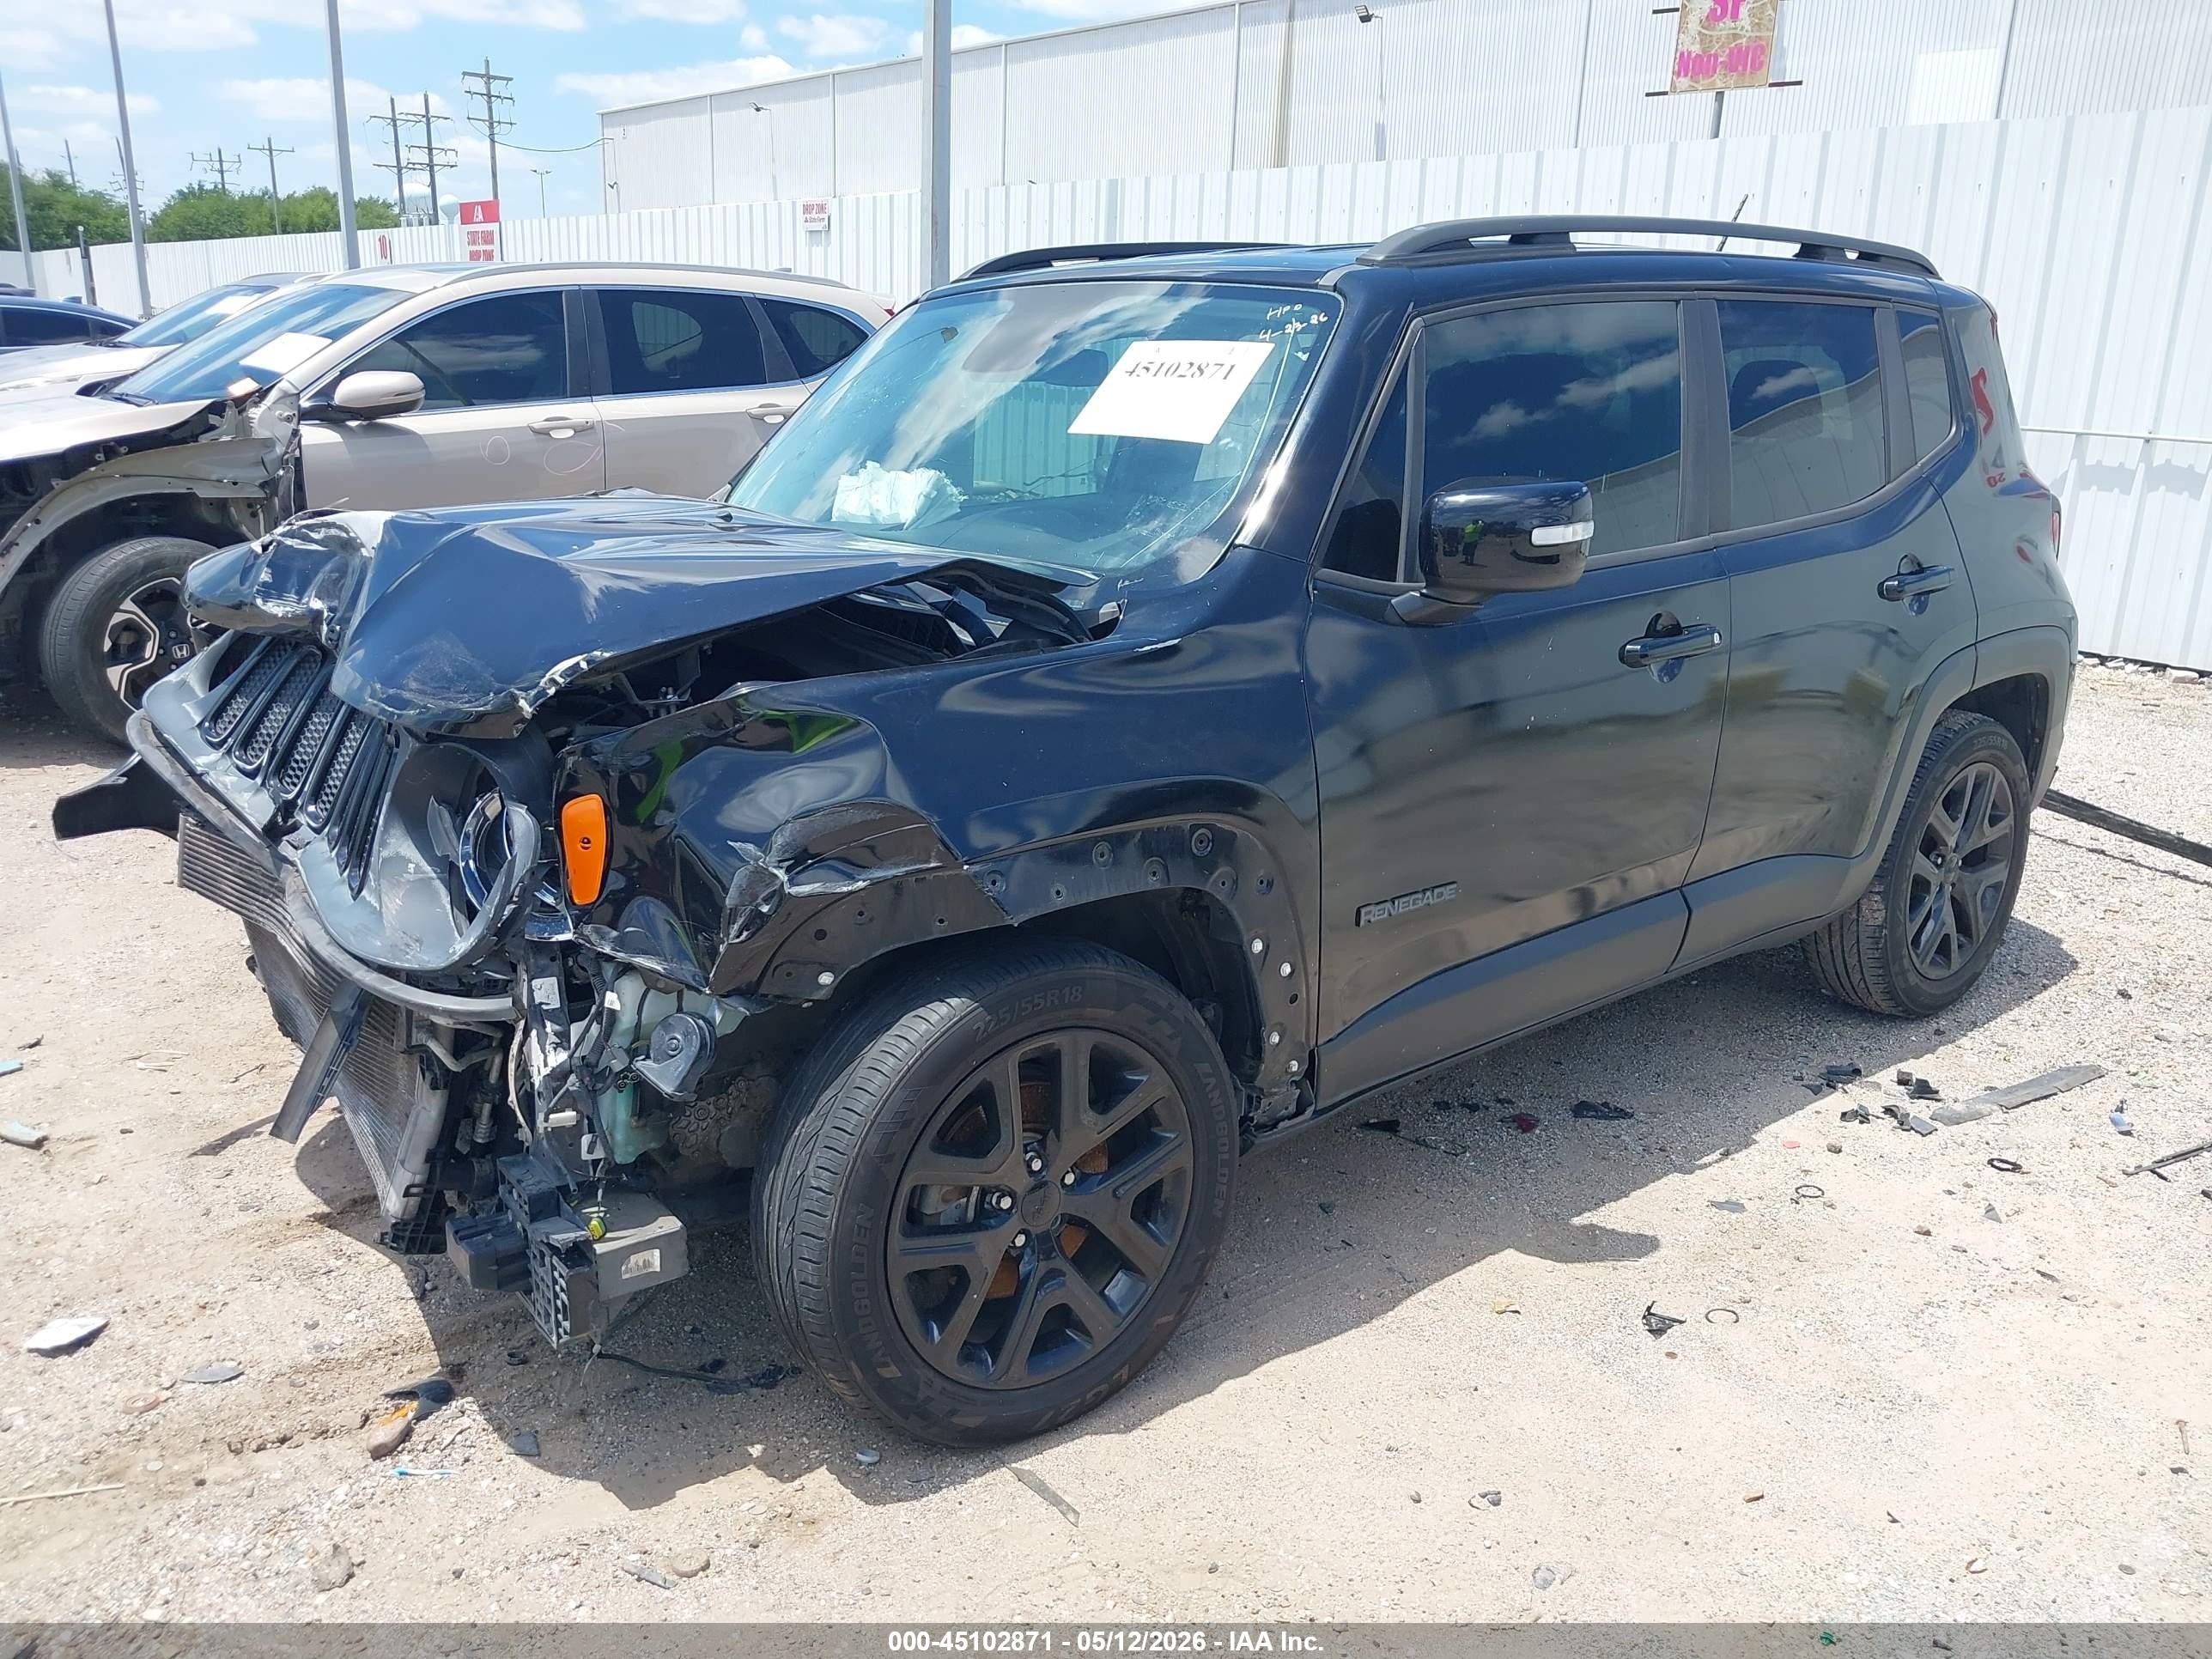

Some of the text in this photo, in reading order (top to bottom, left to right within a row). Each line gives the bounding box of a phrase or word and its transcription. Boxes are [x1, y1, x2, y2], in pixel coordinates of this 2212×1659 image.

[802, 203, 827, 216] DROP ZONE
[378, 234, 388, 260] 10
[466, 229, 495, 247] STATE FARM
[1125, 361, 1237, 380] 45102871
[1355, 880, 1458, 927] RENEGADE
[972, 985, 1084, 1043] 225/55R18
